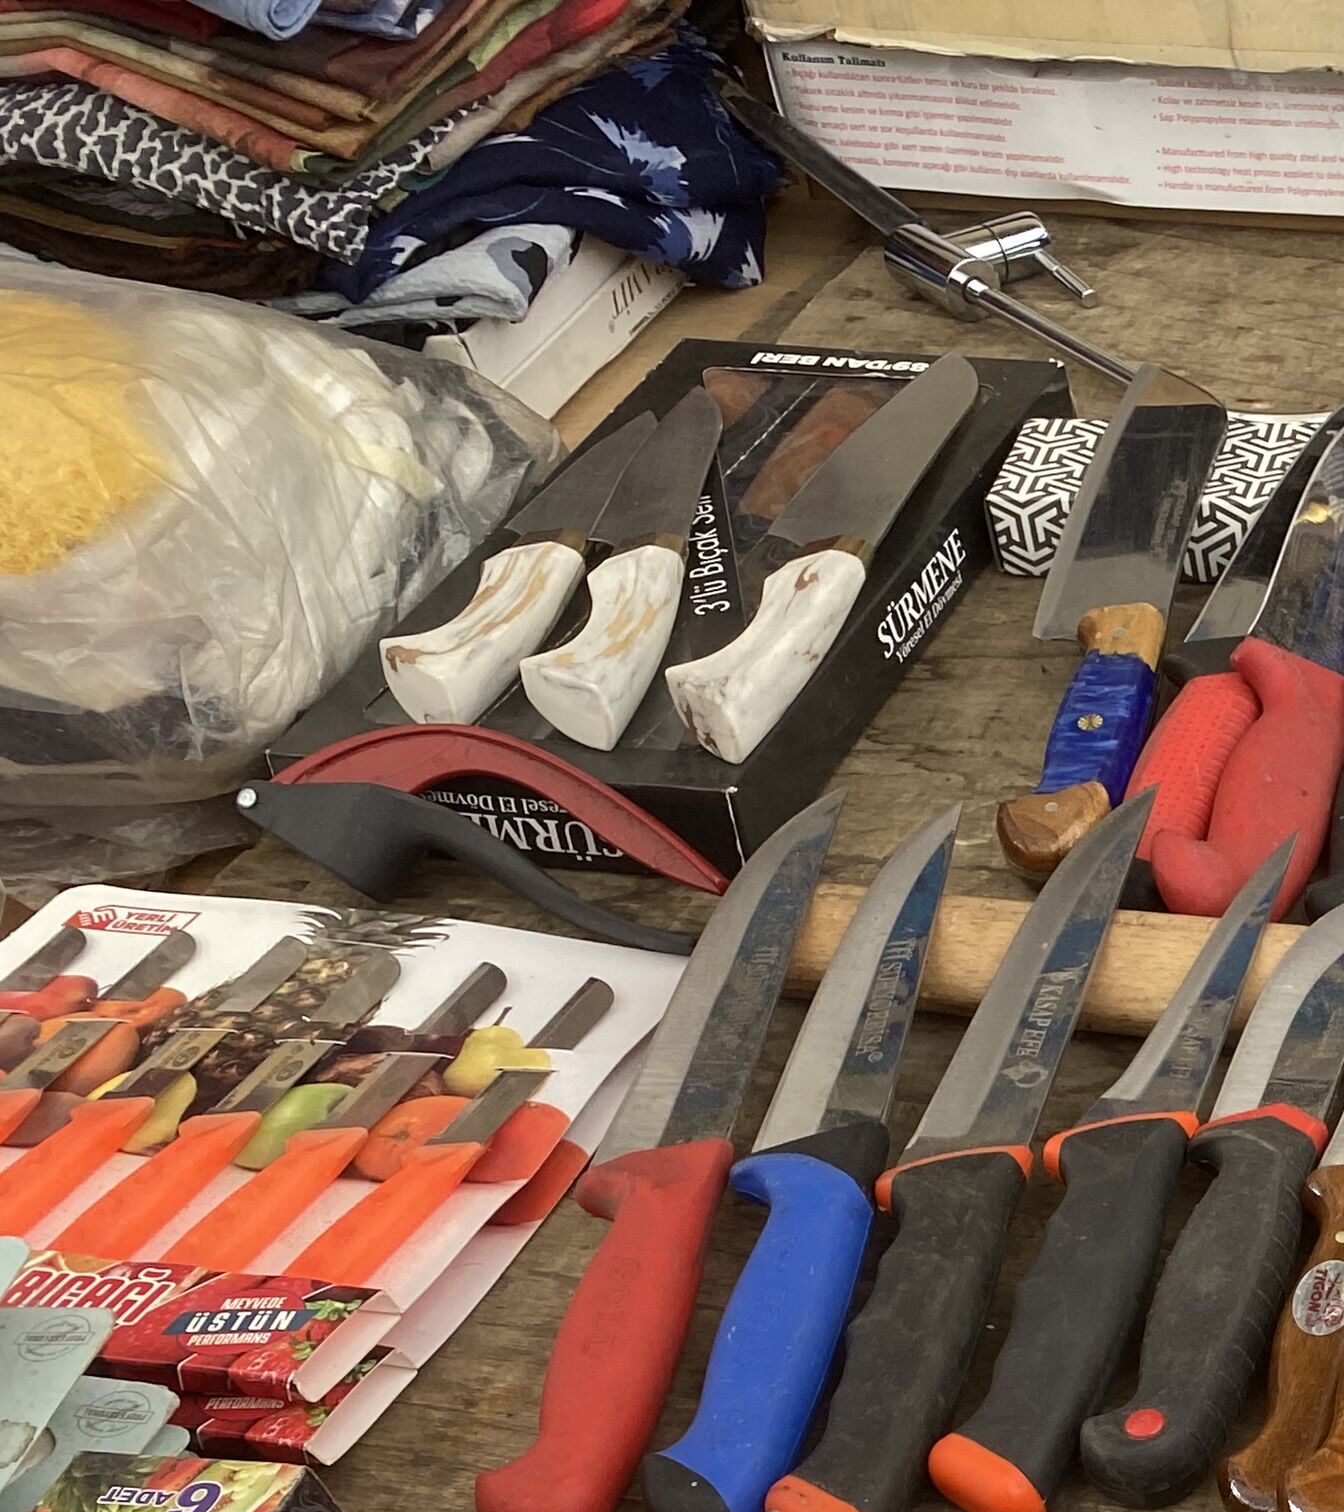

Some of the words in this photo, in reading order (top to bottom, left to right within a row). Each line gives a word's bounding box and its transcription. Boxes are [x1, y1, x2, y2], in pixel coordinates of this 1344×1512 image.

[877, 529, 967, 660] SÜRMENE
[117, 907, 174, 922] YERLİ
[220, 1296, 288, 1311] MEYVEDE
[185, 1310, 298, 1334] ÜSTÜN
[187, 1333, 273, 1346] PERFORMANS
[97, 1486, 172, 1508] ADET
